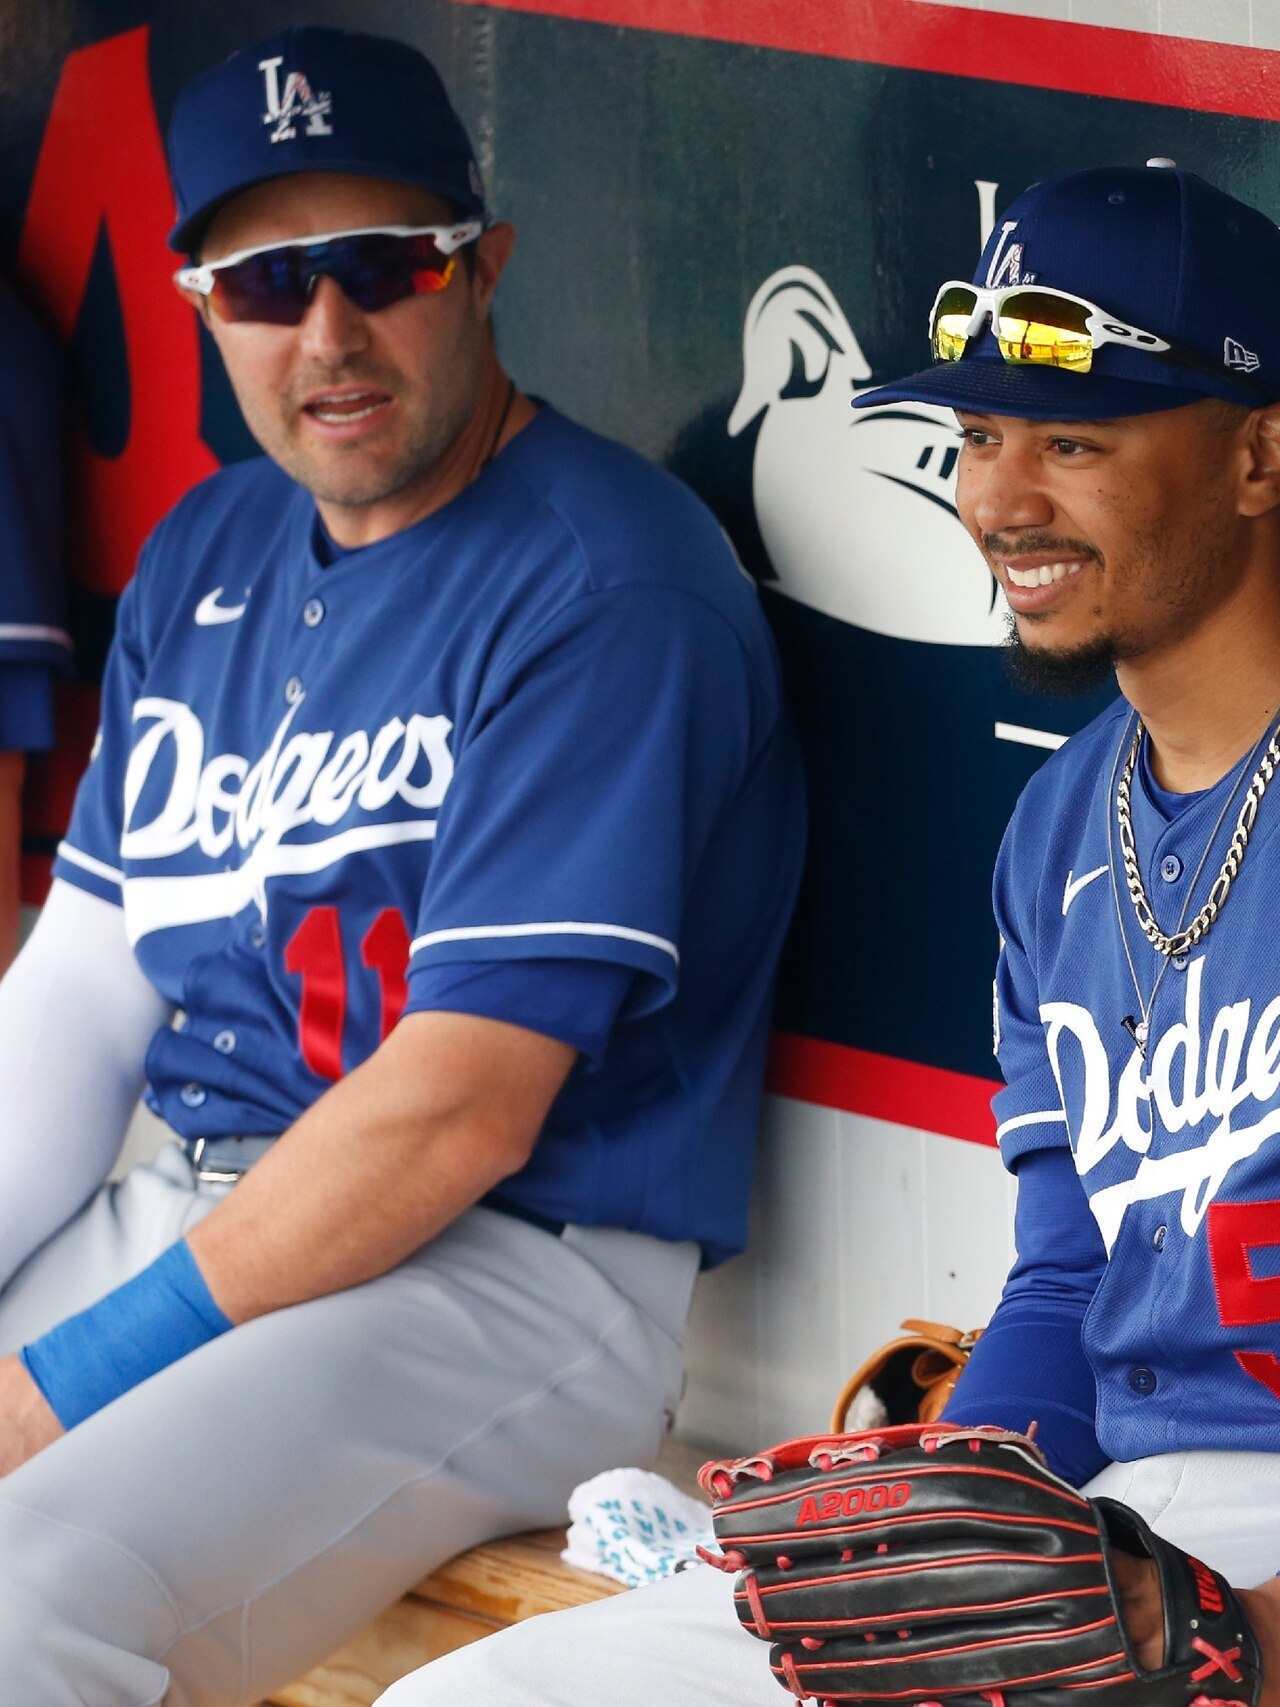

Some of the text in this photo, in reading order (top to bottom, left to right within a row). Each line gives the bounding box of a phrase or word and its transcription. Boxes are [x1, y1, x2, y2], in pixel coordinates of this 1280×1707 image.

[258, 56, 333, 144] LA
[120, 690, 455, 950] Dodgers
[795, 1482, 912, 1528] A2000
